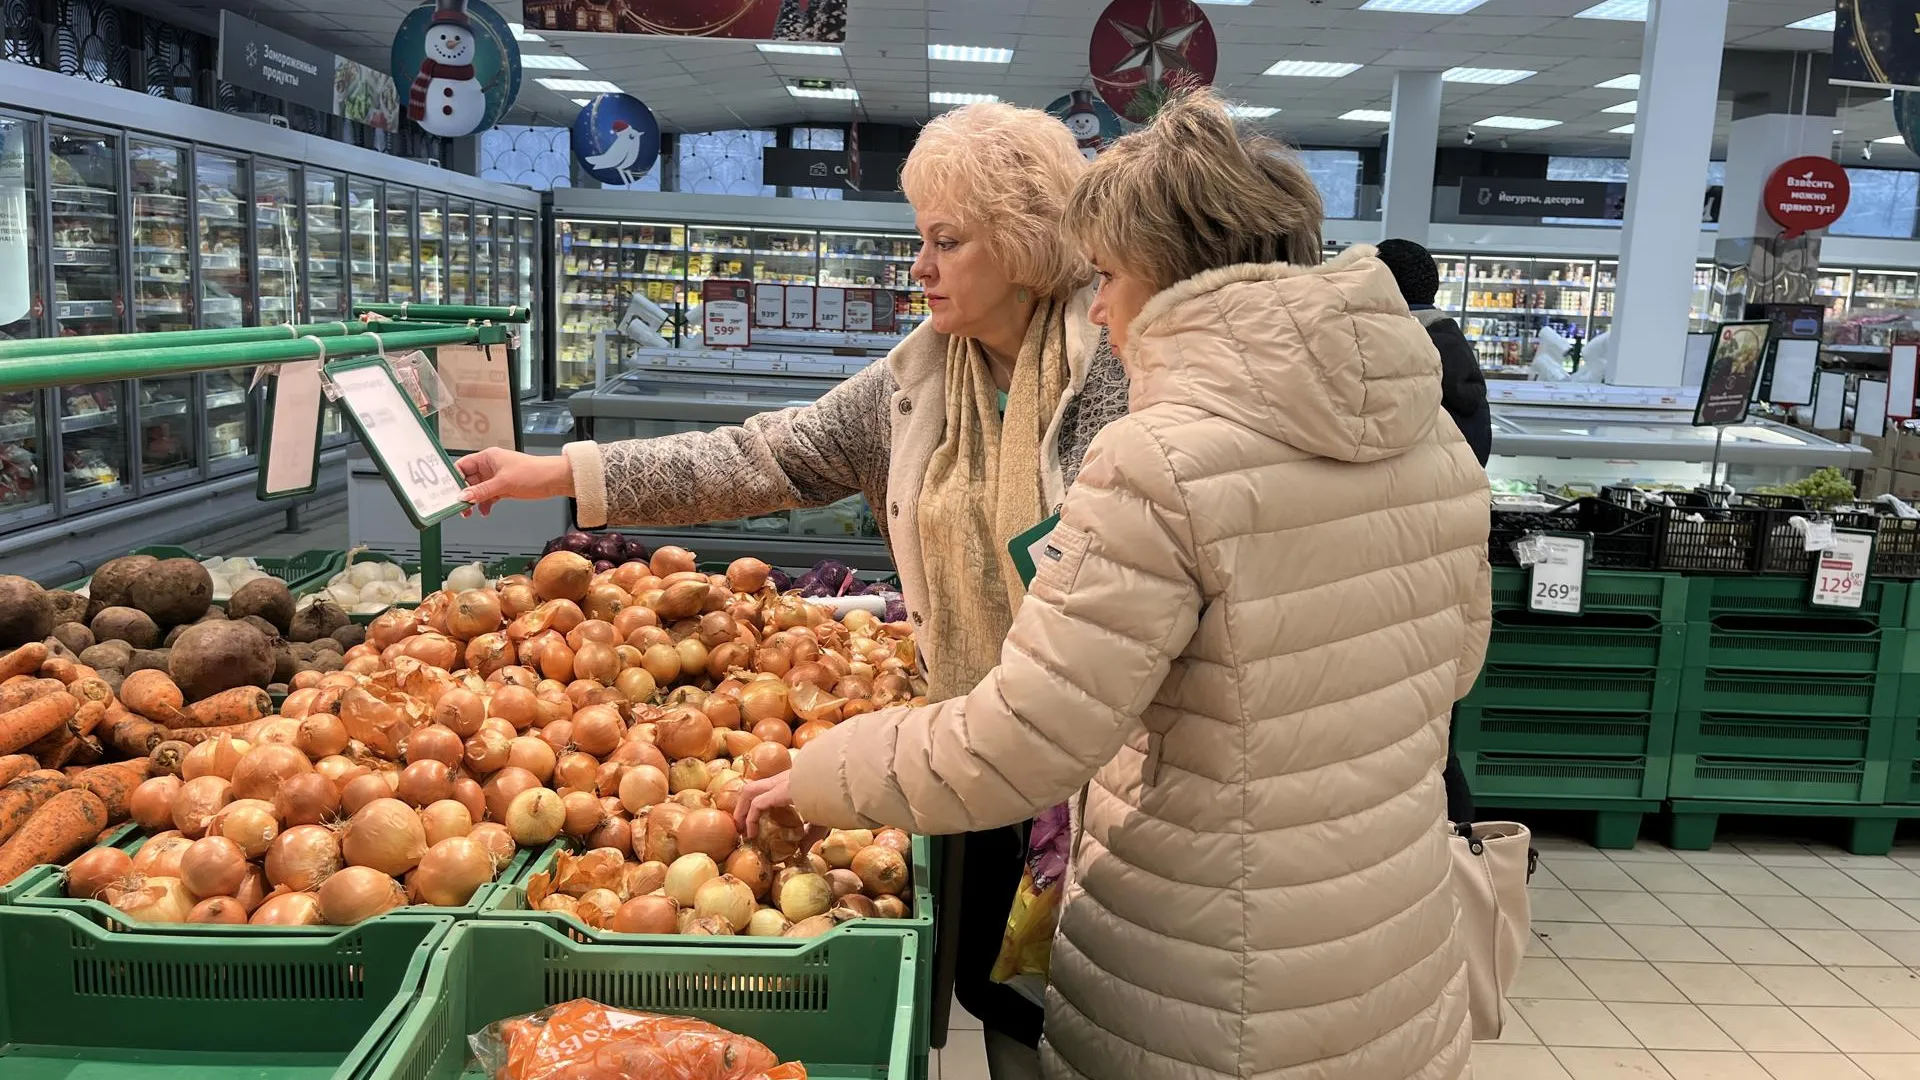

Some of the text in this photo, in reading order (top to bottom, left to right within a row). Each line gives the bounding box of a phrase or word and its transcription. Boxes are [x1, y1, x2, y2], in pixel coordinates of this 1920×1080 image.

[263, 44, 318, 76] Замороженные
[262, 65, 299, 87] продукты
[1786, 176, 1835, 189] Взвесить
[1498, 191, 1585, 206] Йогурты, десерты
[1791, 191, 1827, 201] можно
[1780, 202, 1835, 216] прямо тут!
[713, 325, 735, 336] 599
[407, 457, 439, 489] 40
[1536, 582, 1570, 600] 269
[1819, 576, 1852, 594] 129
